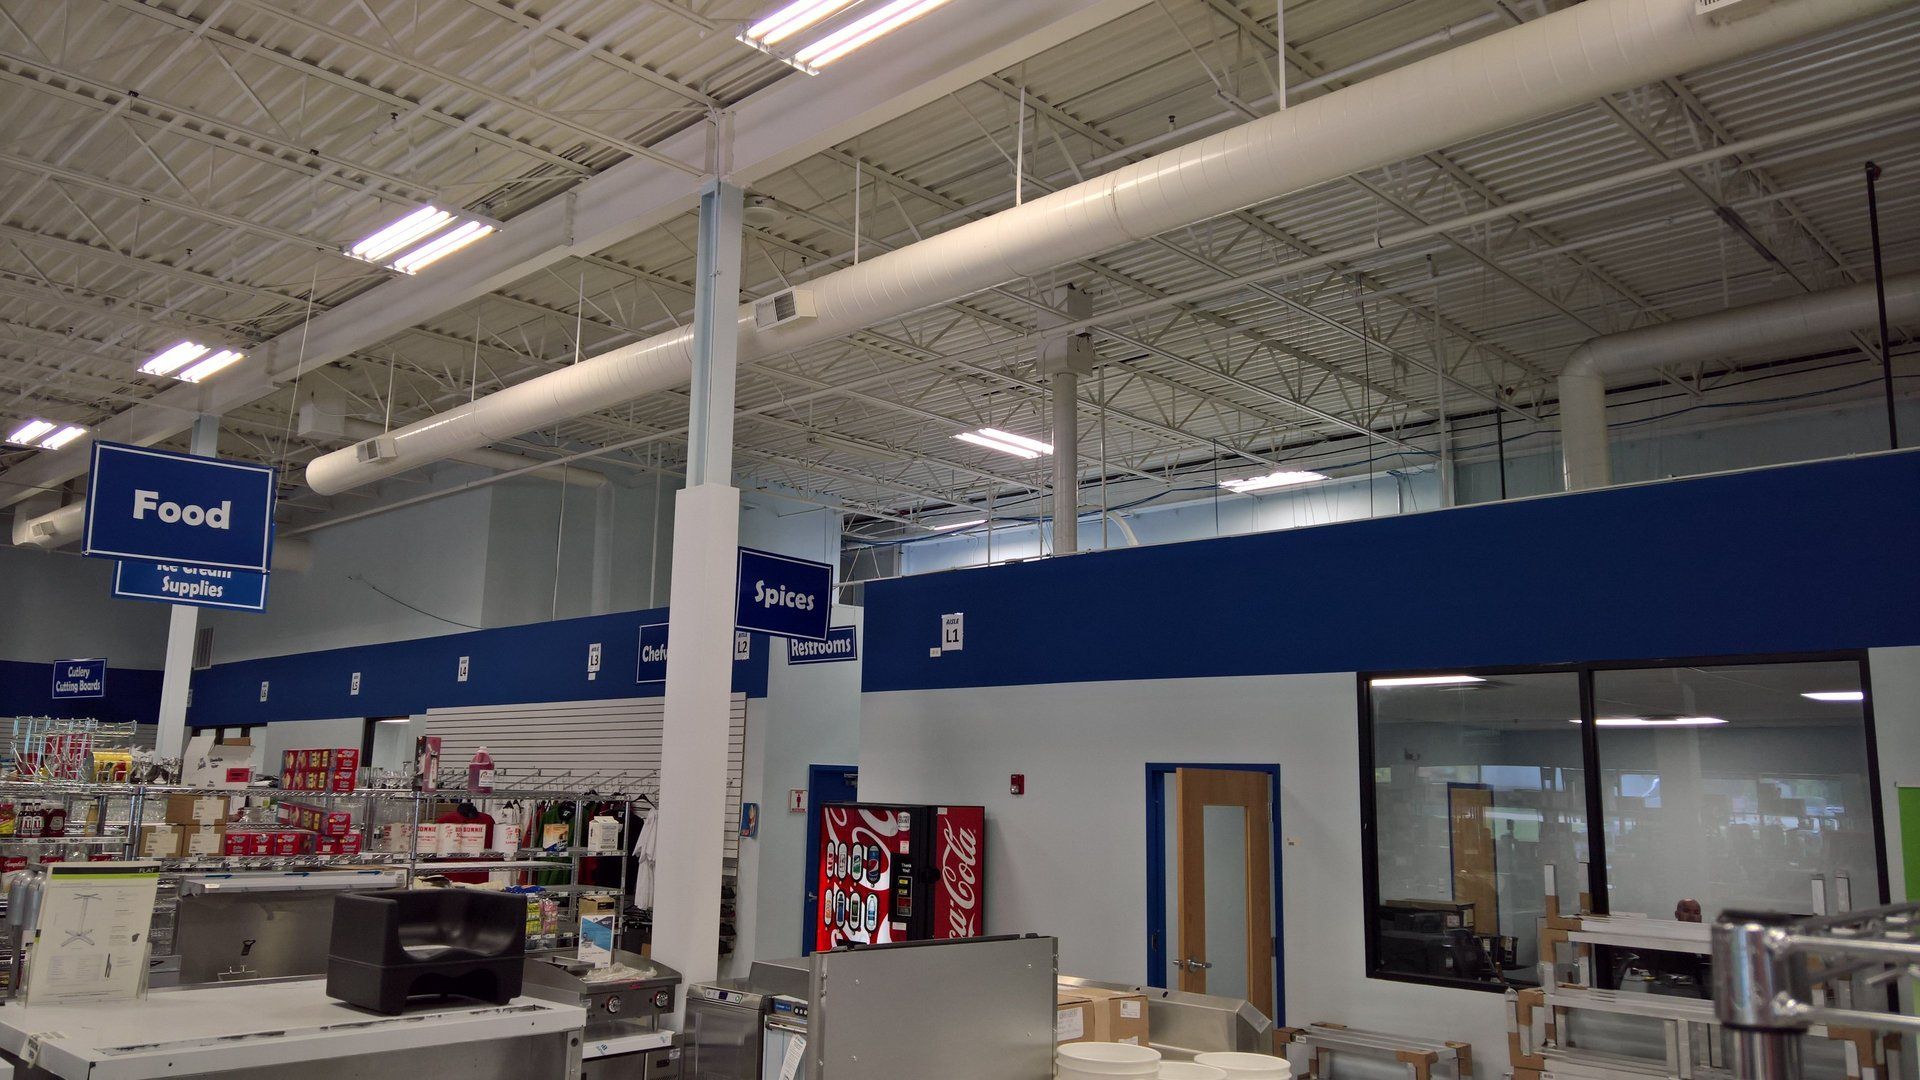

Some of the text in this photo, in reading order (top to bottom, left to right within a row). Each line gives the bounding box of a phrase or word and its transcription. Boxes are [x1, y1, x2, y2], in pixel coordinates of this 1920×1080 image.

[133, 489, 232, 530] Food
[161, 575, 224, 598] Supplies
[754, 580, 815, 611] Spices
[946, 628, 960, 643] L1
[737, 640, 748, 654] L2
[791, 638, 851, 657] Restrooms
[590, 654, 599, 666] L3
[68, 666, 90, 680] Cutlery
[55, 679, 101, 694] Cutting Boards
